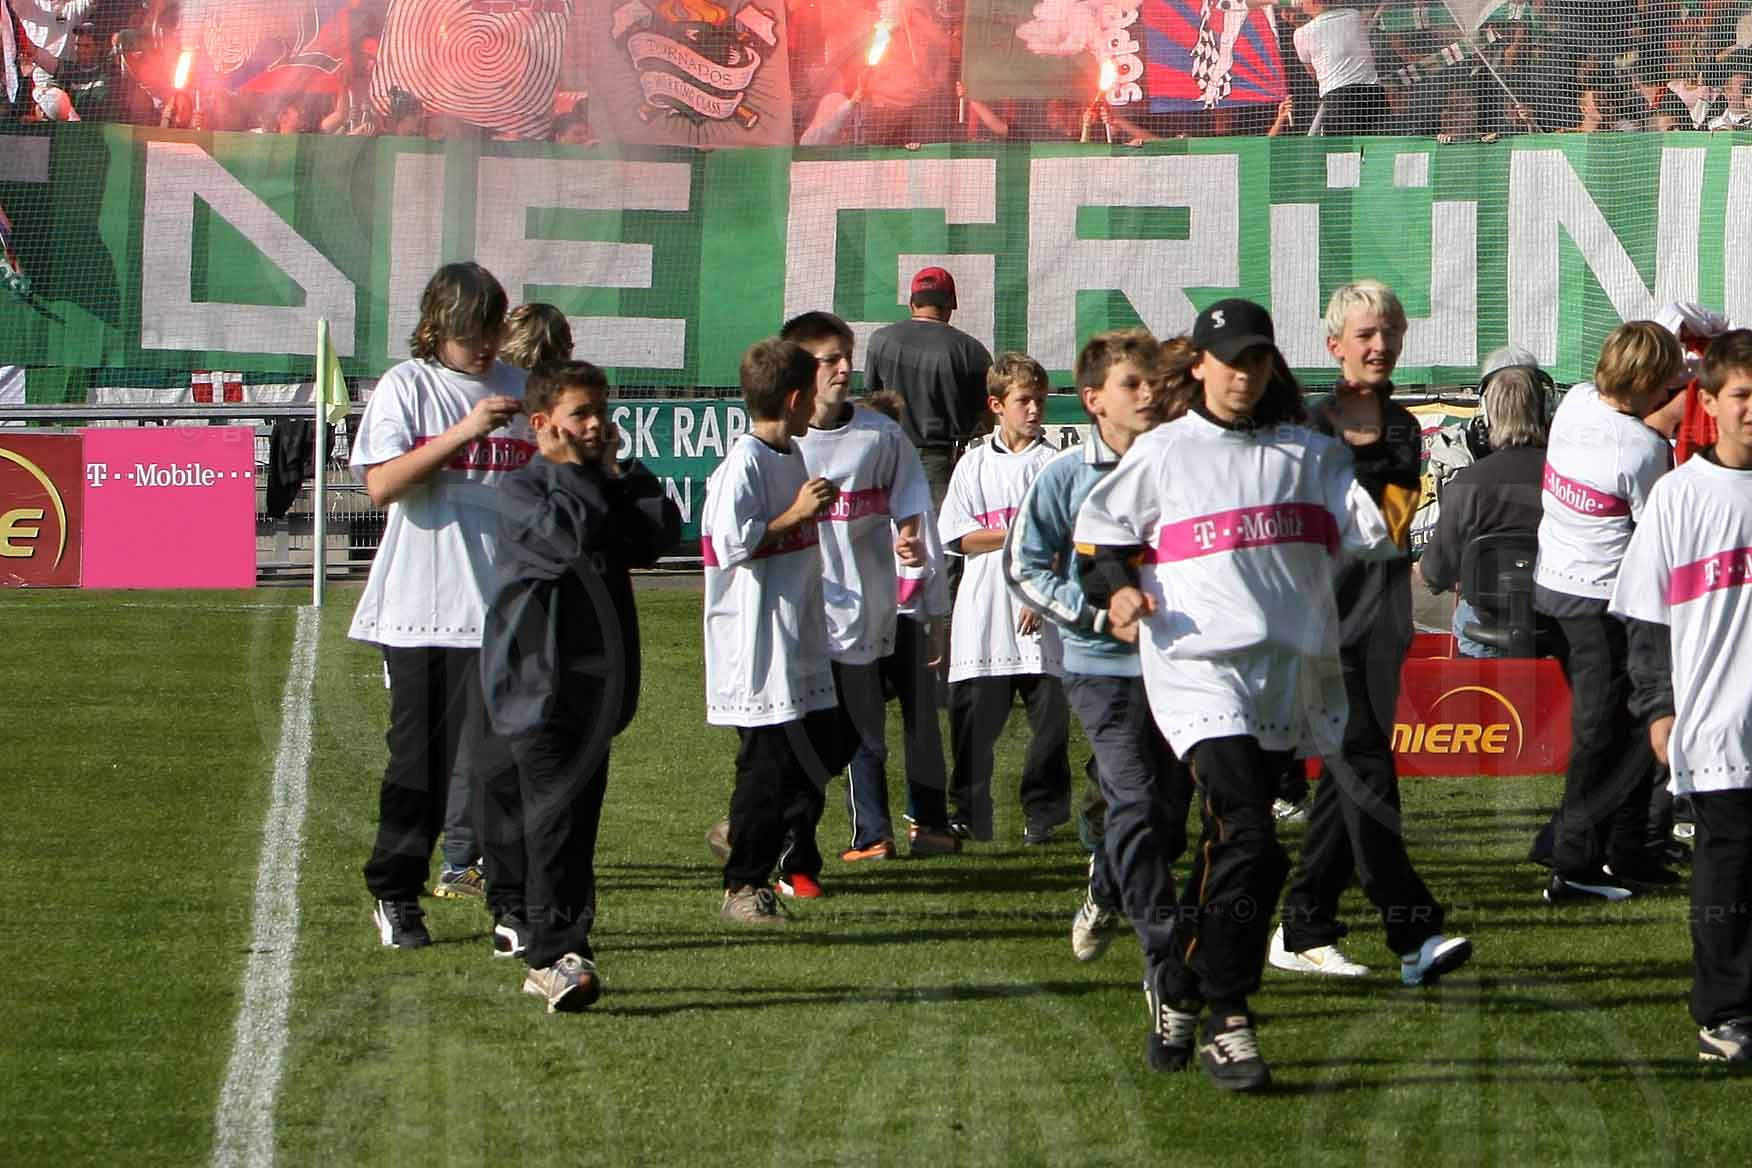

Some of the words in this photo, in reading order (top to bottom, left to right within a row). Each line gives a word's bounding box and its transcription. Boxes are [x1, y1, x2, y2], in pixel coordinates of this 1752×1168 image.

[141, 140, 692, 370] DIE
[612, 406, 660, 459] SK
[673, 406, 753, 457] RAP
